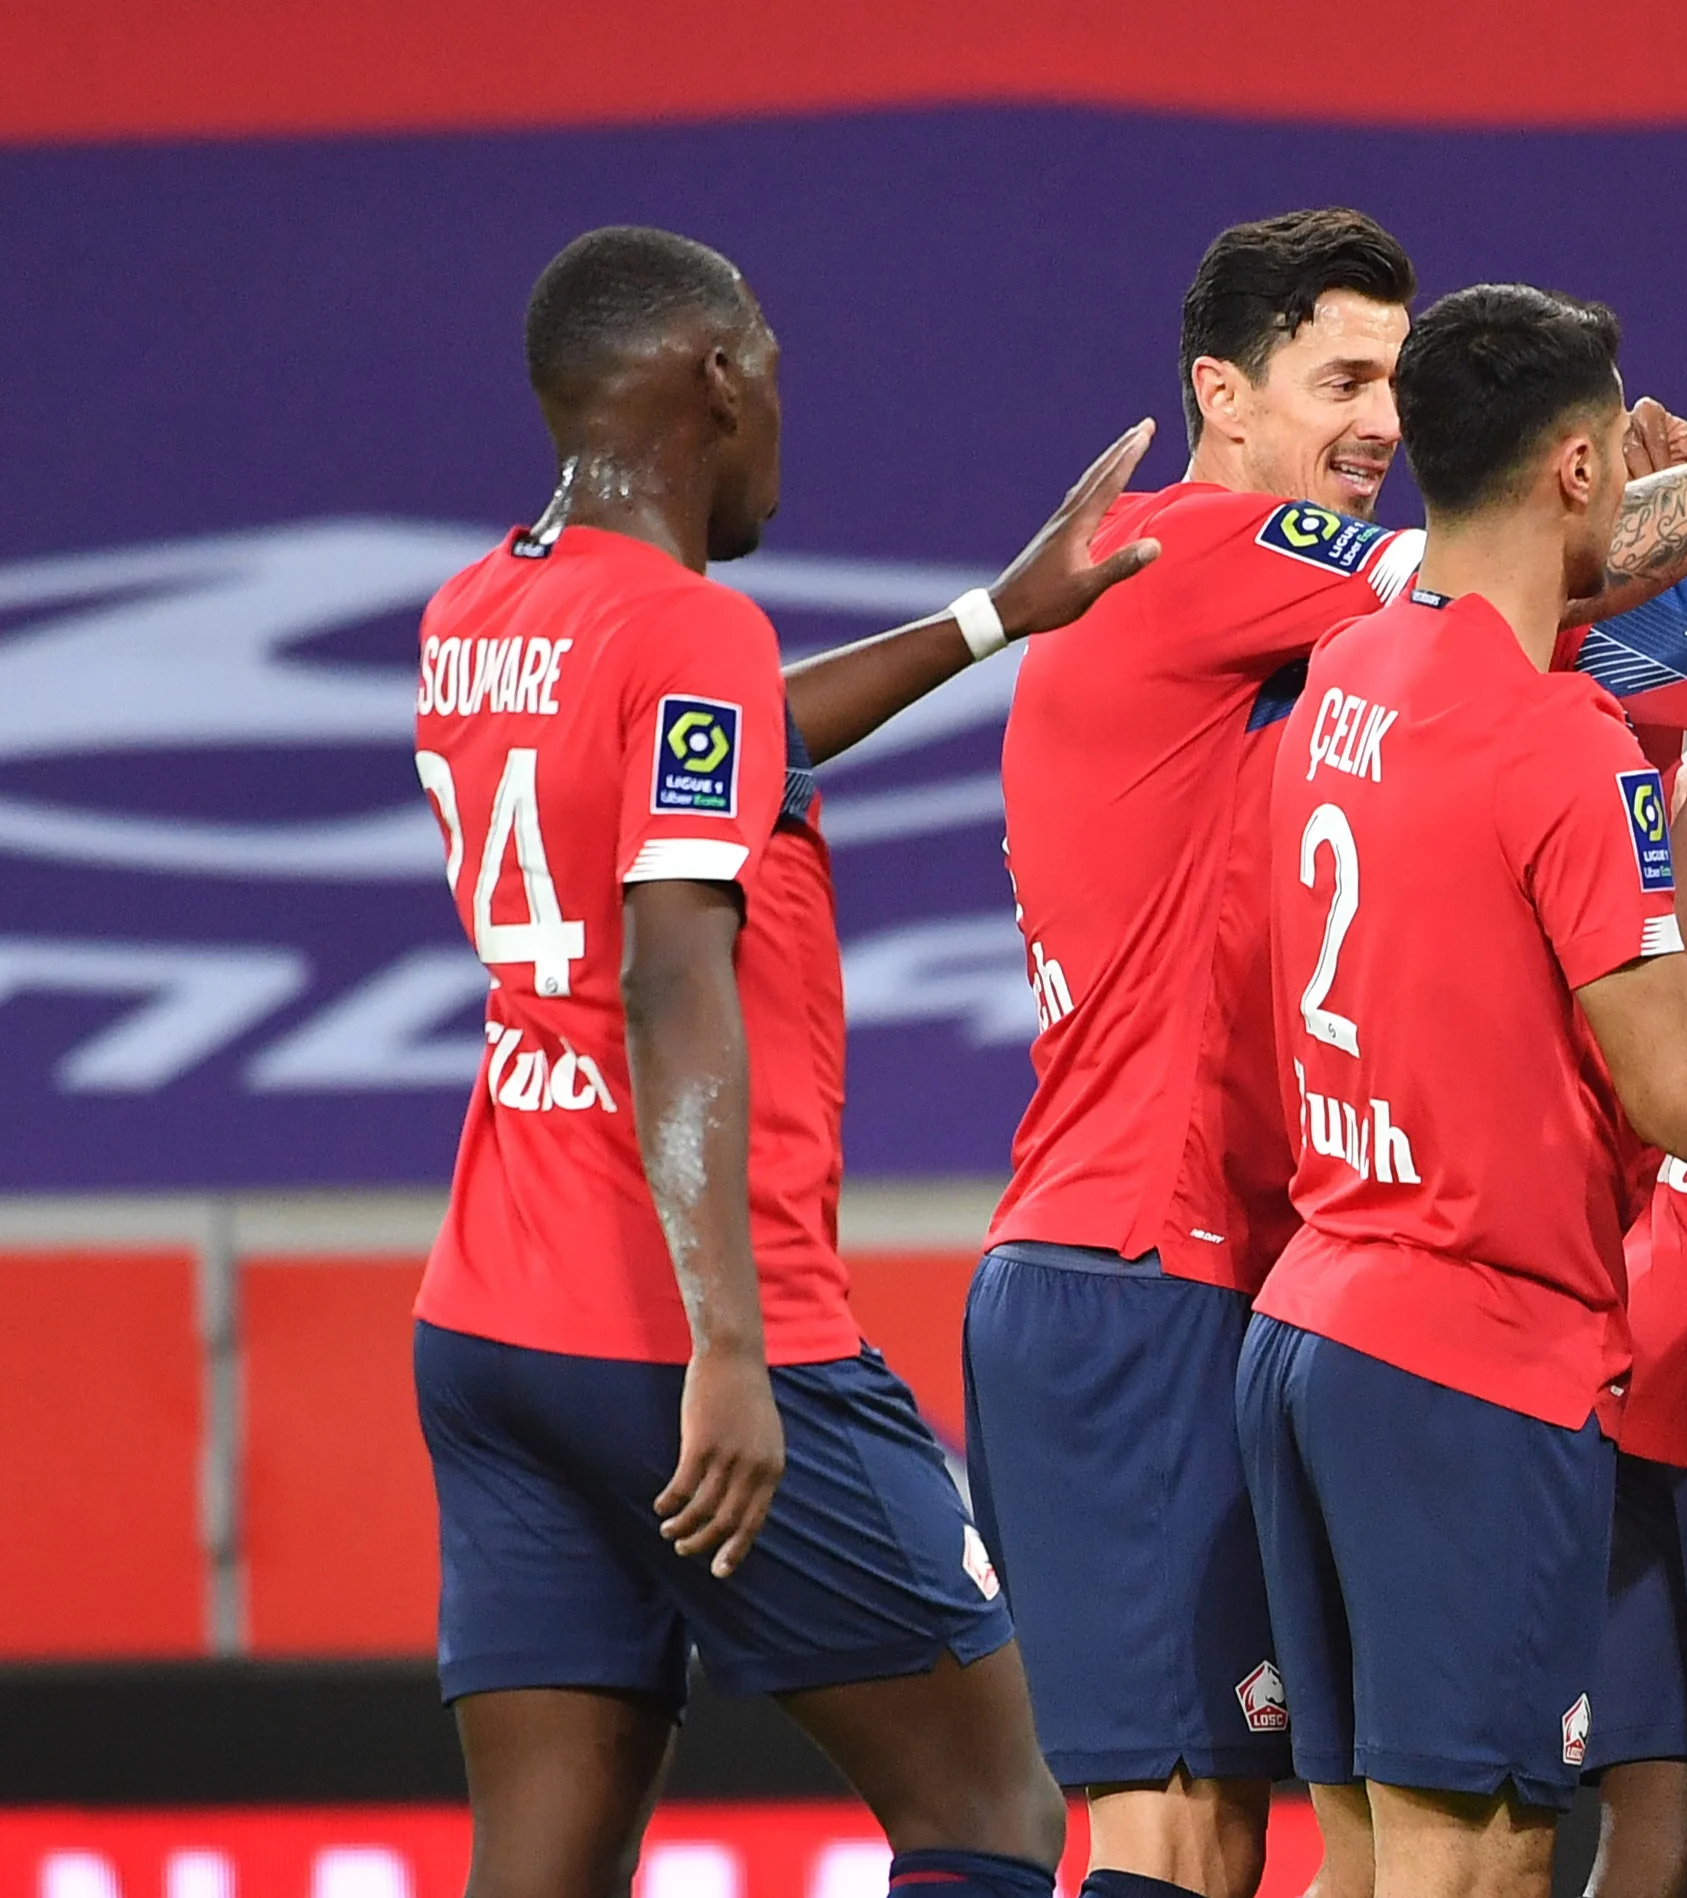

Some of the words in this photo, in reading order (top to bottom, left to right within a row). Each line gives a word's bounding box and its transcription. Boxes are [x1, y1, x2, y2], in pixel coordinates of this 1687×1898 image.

[1328, 524, 1361, 558] LIGUE
[418, 634, 574, 717] SOUMARE
[1305, 686, 1399, 783] ÇELIK
[660, 790, 692, 804] Uber
[665, 774, 713, 793] LIGUE
[715, 781, 724, 794] 1
[1299, 803, 1361, 1059] 2
[1253, 1713, 1284, 1727] LOSC
